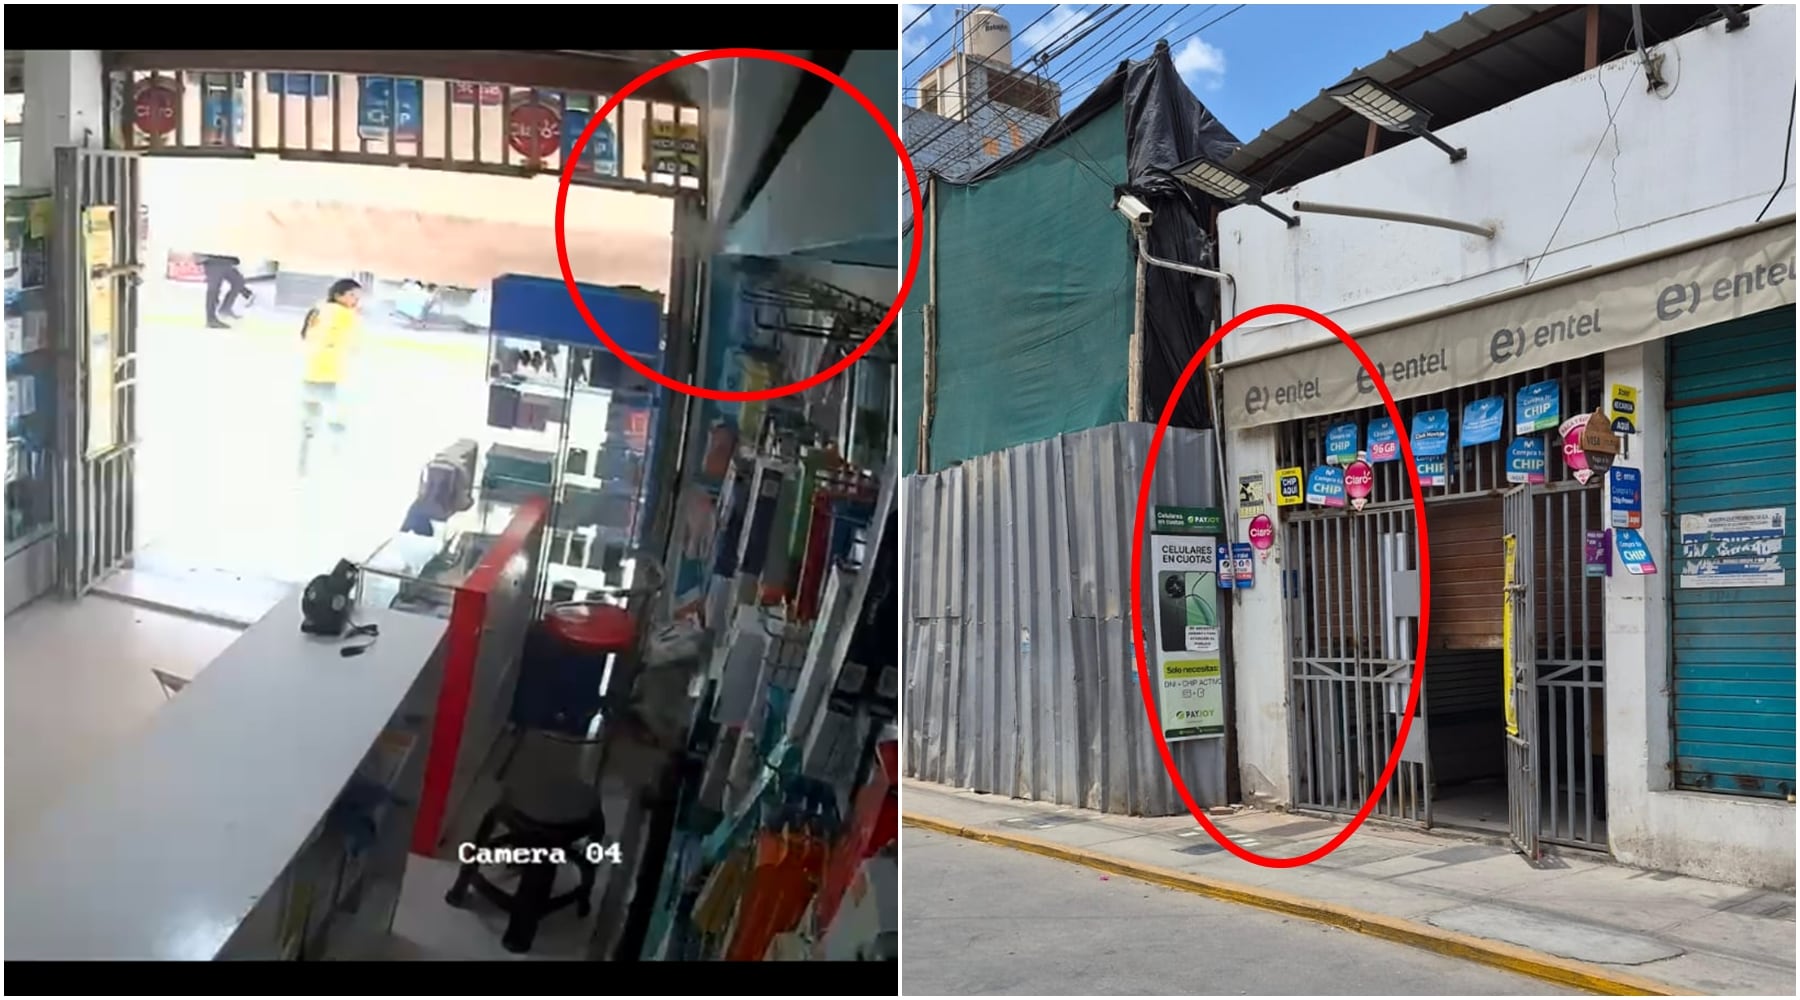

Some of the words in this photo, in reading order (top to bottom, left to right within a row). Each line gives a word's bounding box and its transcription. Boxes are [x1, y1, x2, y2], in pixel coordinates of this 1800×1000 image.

[1533, 308, 1602, 348] entel
[1392, 348, 1448, 383] entel
[1275, 377, 1322, 404] entel
[1524, 402, 1552, 418] CHIP
[1330, 440, 1351, 452] CHIP
[1512, 458, 1545, 471] CHIP
[1282, 477, 1297, 487] CHIP
[1345, 474, 1370, 486] Claro
[1313, 483, 1342, 495] CHIP
[1161, 544, 1213, 555] CELULARES
[1623, 549, 1647, 562] CHIP
[1162, 555, 1175, 564] EN
[1176, 555, 1213, 564] CUOTAS
[1182, 679, 1199, 687] CHIP
[1185, 709, 1215, 719] PAYJOY
